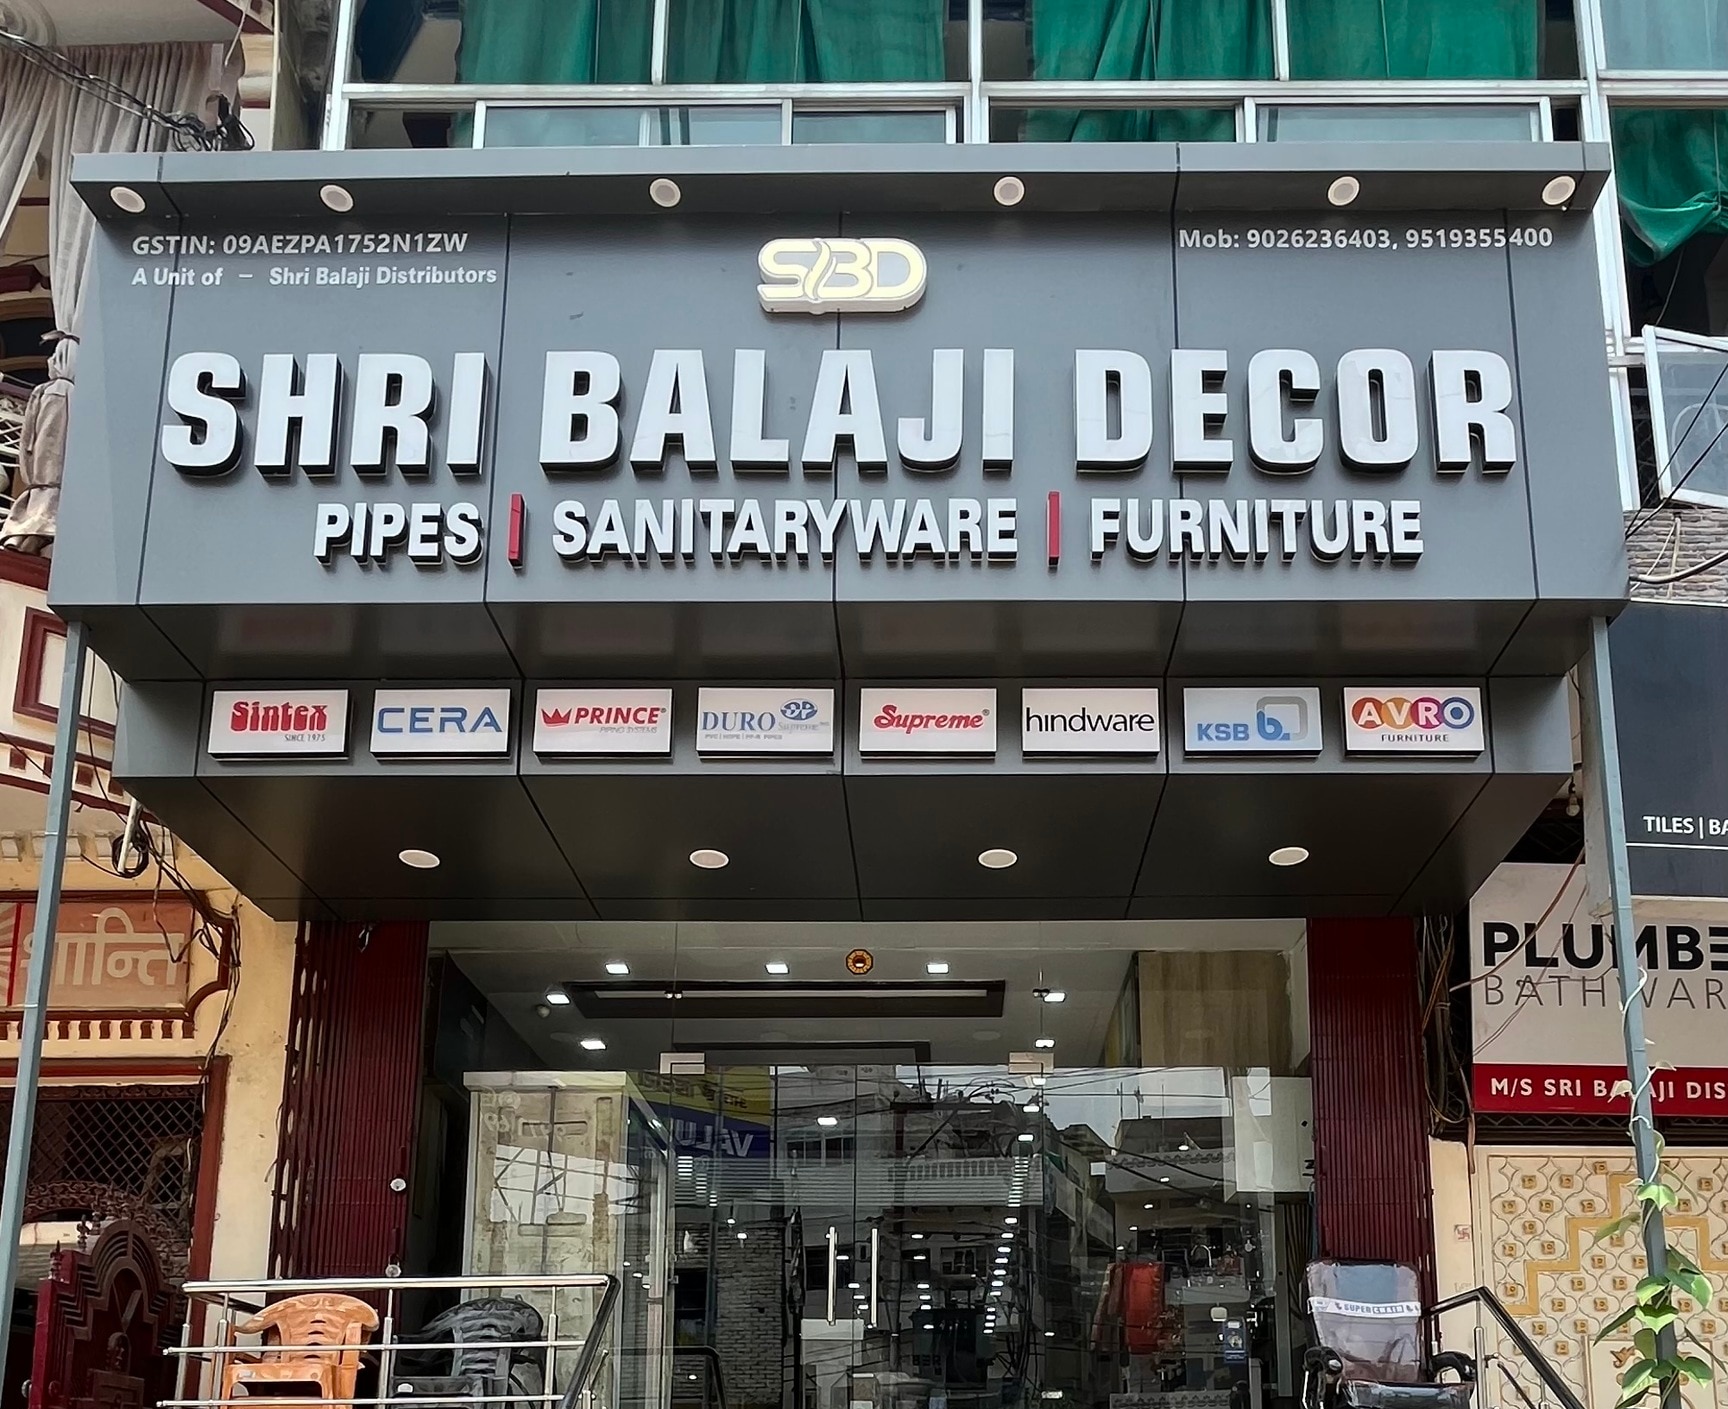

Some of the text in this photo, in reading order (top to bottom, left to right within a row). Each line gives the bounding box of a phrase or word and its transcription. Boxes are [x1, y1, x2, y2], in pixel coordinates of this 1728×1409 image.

[131, 233, 468, 256] GSTIN: 09AEZPA1752N1ZW
[1178, 227, 1554, 250] Mob: 9026236403, 9519355400
[131, 265, 498, 289] A Unit of Shri Balaji Distributors
[757, 238, 927, 300] SBD
[161, 348, 1518, 475] SHRI BALAJI DECOR
[314, 498, 1425, 563] PIPES SANITARYWARE FURNITURE
[230, 701, 328, 732] Sintex
[377, 706, 503, 733] CERA
[574, 707, 661, 724] PRINCE
[702, 711, 776, 731] DURO
[874, 704, 984, 734] Supreme
[1026, 706, 1155, 732] hindware
[1355, 699, 1473, 728] AVRO
[284, 734, 326, 742] SINCE 1975
[1197, 723, 1250, 741] KSB
[1381, 733, 1449, 743] FURNITURE
[1642, 815, 1695, 834] TILES
[1490, 1077, 1533, 1098] M/S
[1543, 1078, 1582, 1097] SRI
[1593, 1078, 1675, 1103] BJI
